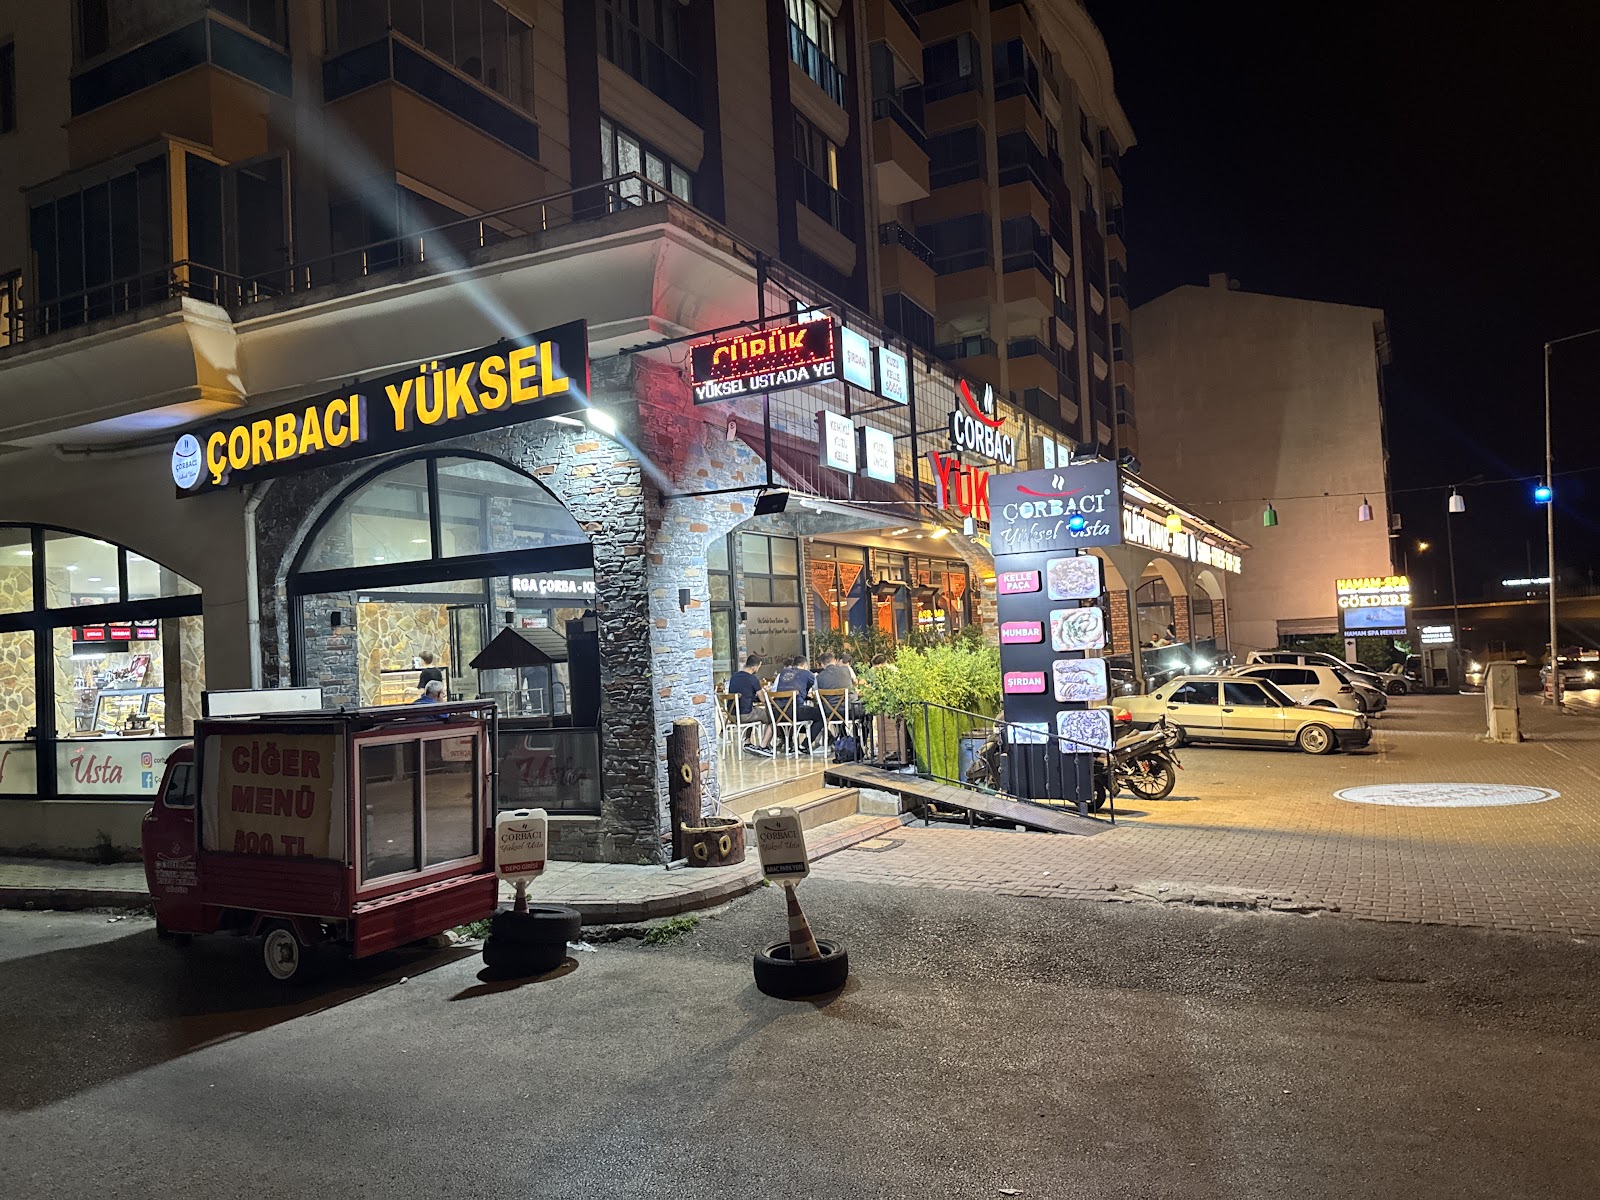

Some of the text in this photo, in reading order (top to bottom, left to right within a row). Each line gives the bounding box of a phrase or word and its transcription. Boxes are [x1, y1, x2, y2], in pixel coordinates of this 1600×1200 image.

[695, 361, 835, 400] YÜKSEL USTADA YE
[206, 340, 569, 484] ÇORBACI YÜKSEL
[954, 410, 1016, 466] ÇORBACI
[1002, 494, 1106, 525] ÇORBACI
[1000, 520, 1064, 545] Yüksel
[539, 578, 577, 594] ÇORBA
[1003, 572, 1032, 583] KELLE
[1006, 580, 1031, 590] PAÇA
[1338, 593, 1412, 608] GÖKDERE
[1002, 628, 1039, 637] MUMBAR
[1007, 678, 1041, 687] ŞIRDAN
[70, 754, 123, 784] Usta
[232, 741, 321, 778] CİĞER
[232, 784, 316, 819] MENÜ
[501, 831, 542, 843] ÇORBACI
[760, 831, 797, 842] ÇORBACI
